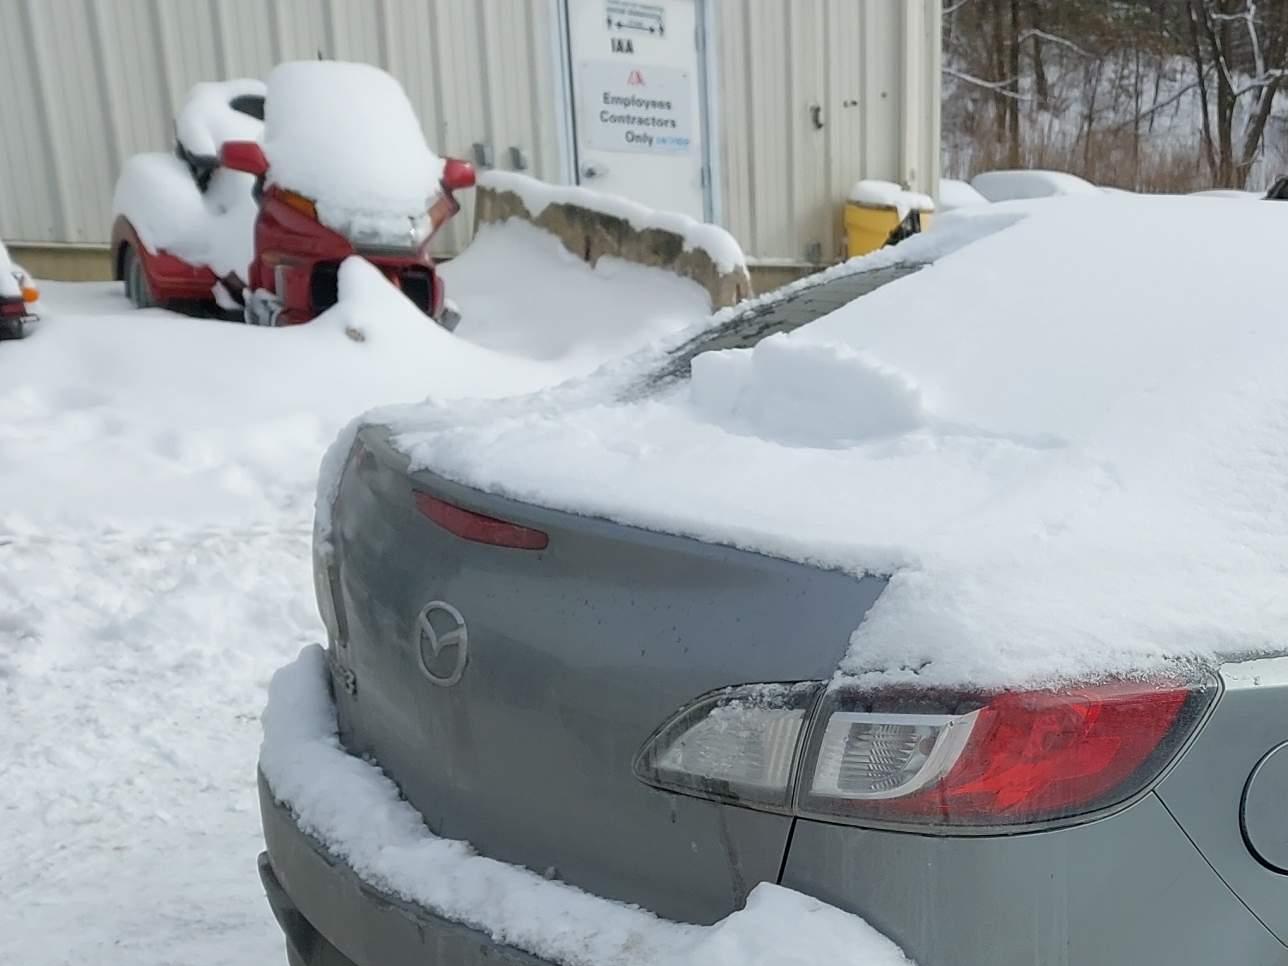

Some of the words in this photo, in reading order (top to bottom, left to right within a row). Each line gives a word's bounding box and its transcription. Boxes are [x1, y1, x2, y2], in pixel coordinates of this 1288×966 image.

[611, 38, 634, 54] IAA
[603, 92, 672, 111] Employees
[599, 110, 677, 129] Contractors
[625, 130, 654, 147] Only
